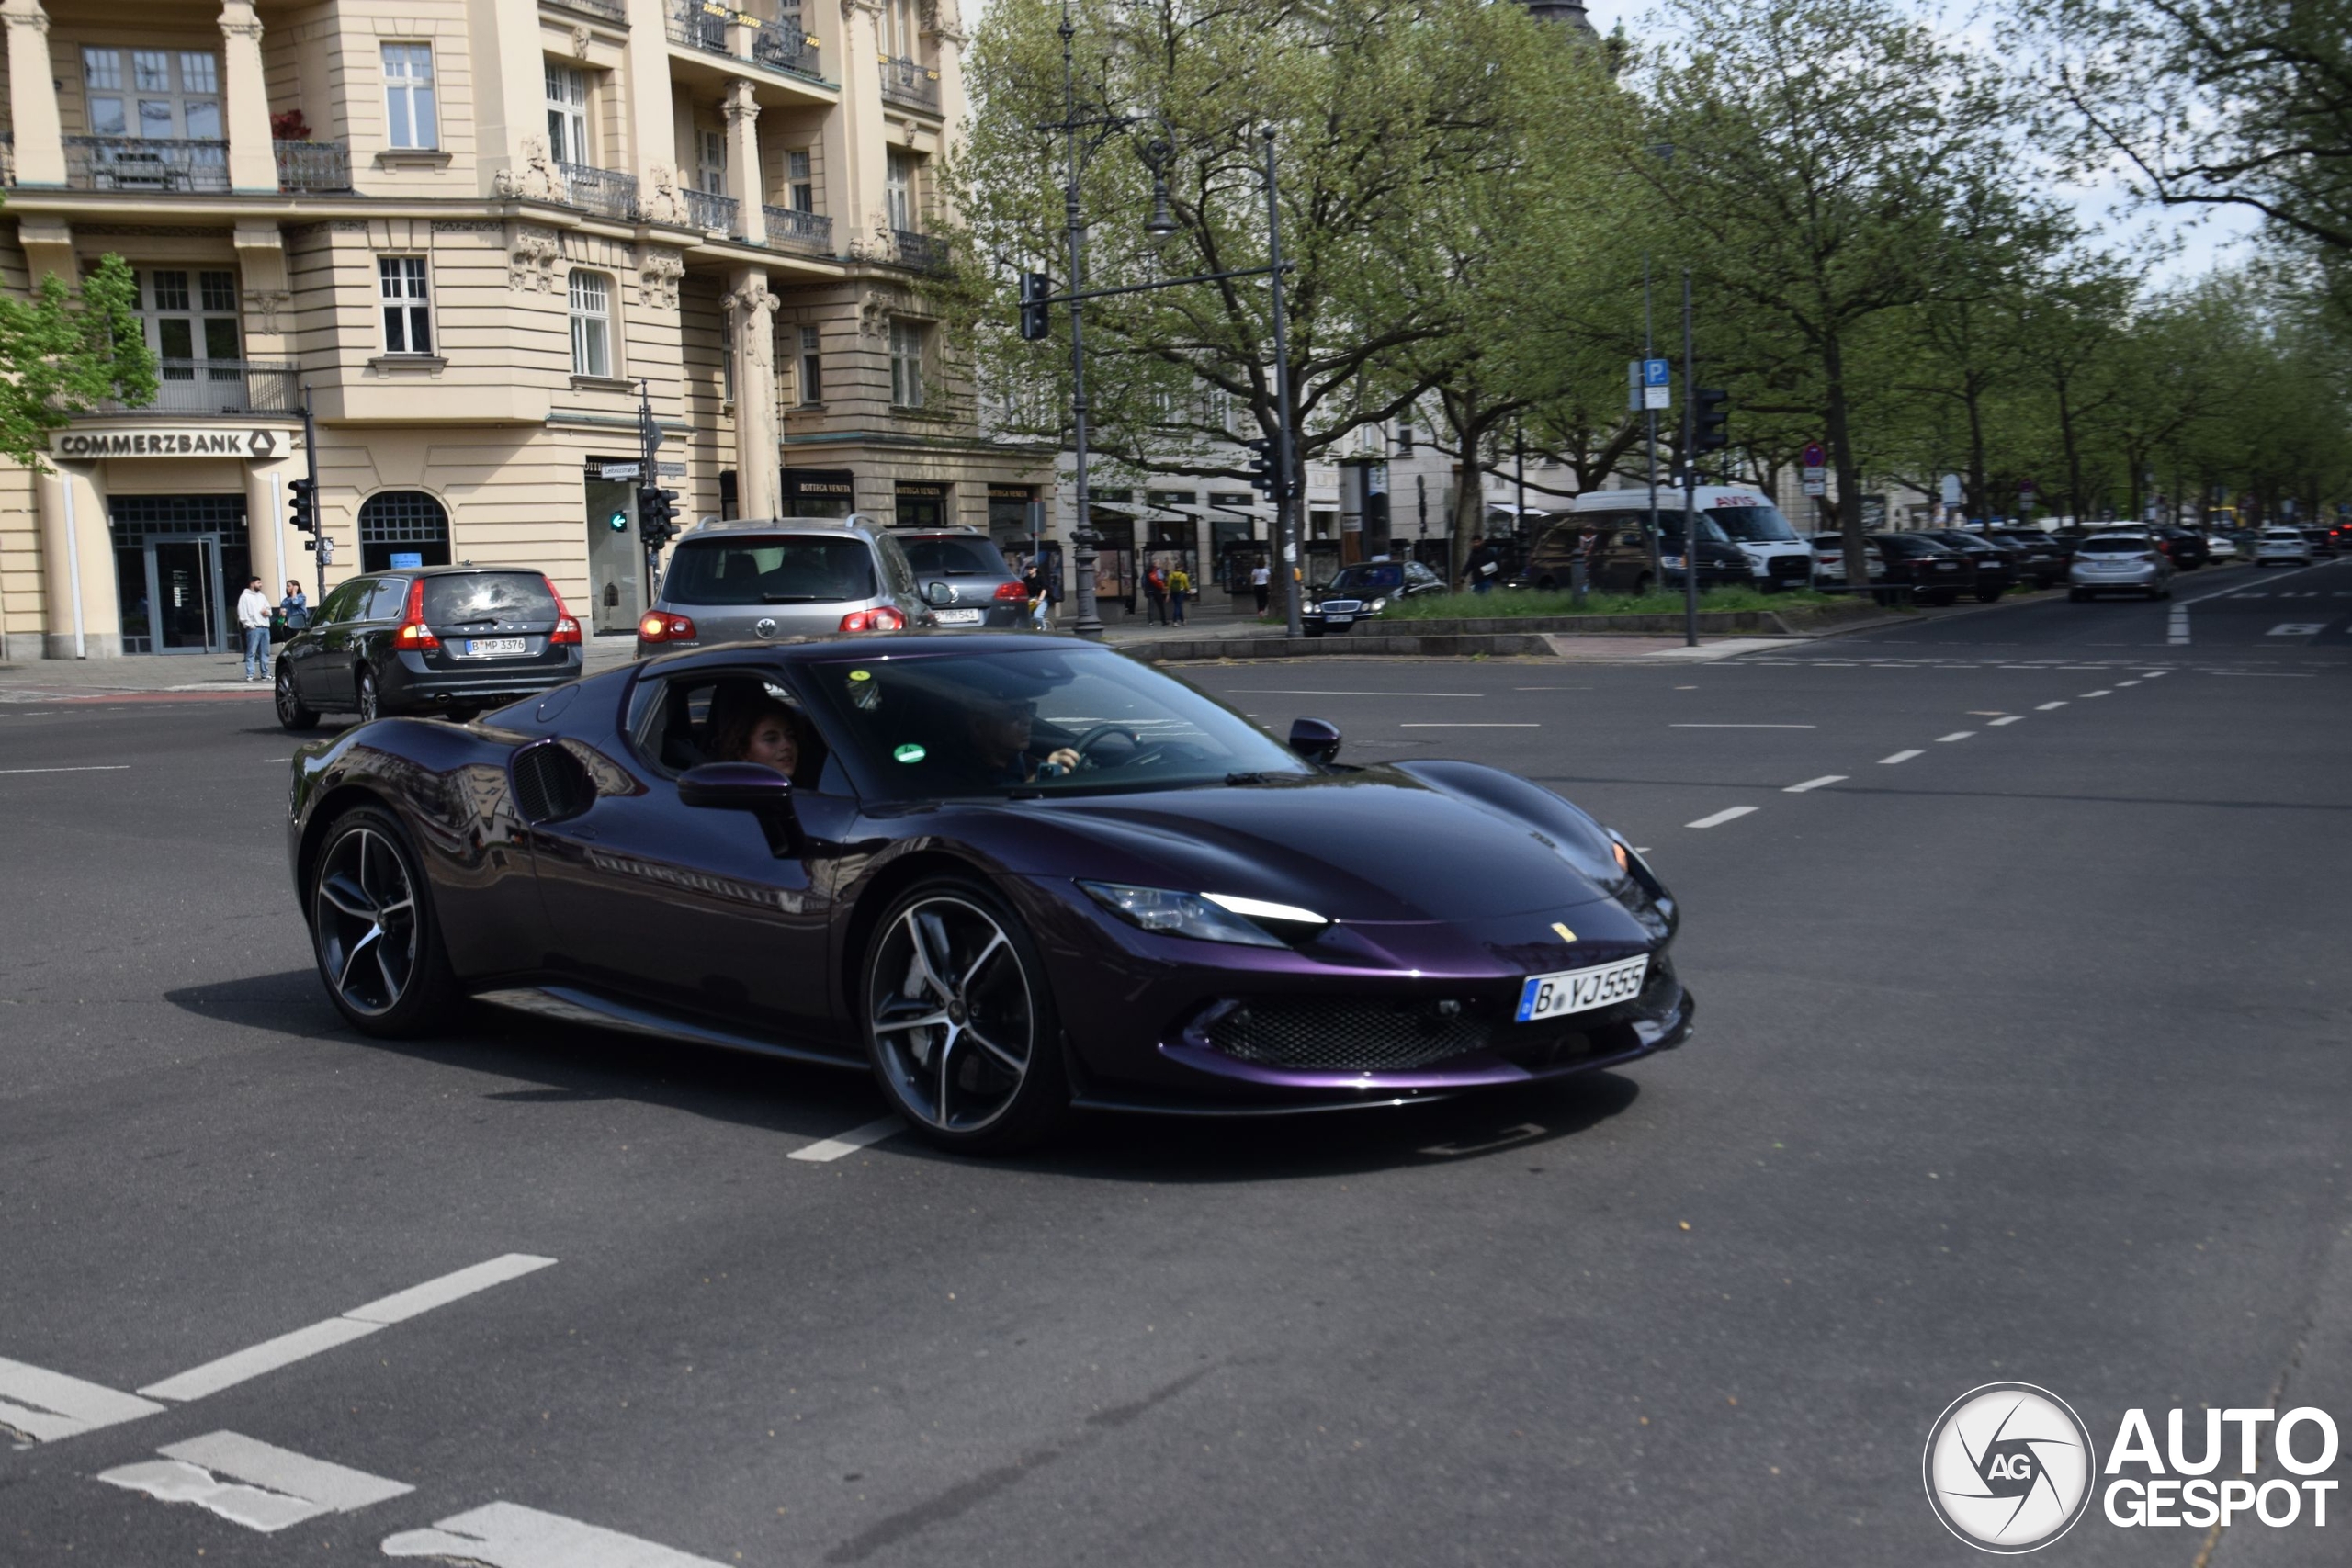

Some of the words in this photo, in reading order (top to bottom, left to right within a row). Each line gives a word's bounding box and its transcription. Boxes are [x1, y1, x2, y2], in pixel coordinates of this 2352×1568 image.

[1649, 363, 1663, 382] P
[61, 434, 242, 453] COMMERZBANK
[800, 483, 828, 492] BOTTEGA
[829, 484, 851, 493] VENETA
[920, 487, 941, 495] VENETA
[1715, 496, 1757, 507] AVIS
[472, 641, 480, 651] B
[485, 640, 498, 650] MP
[501, 639, 525, 650] 3376
[1535, 983, 1554, 1013] B
